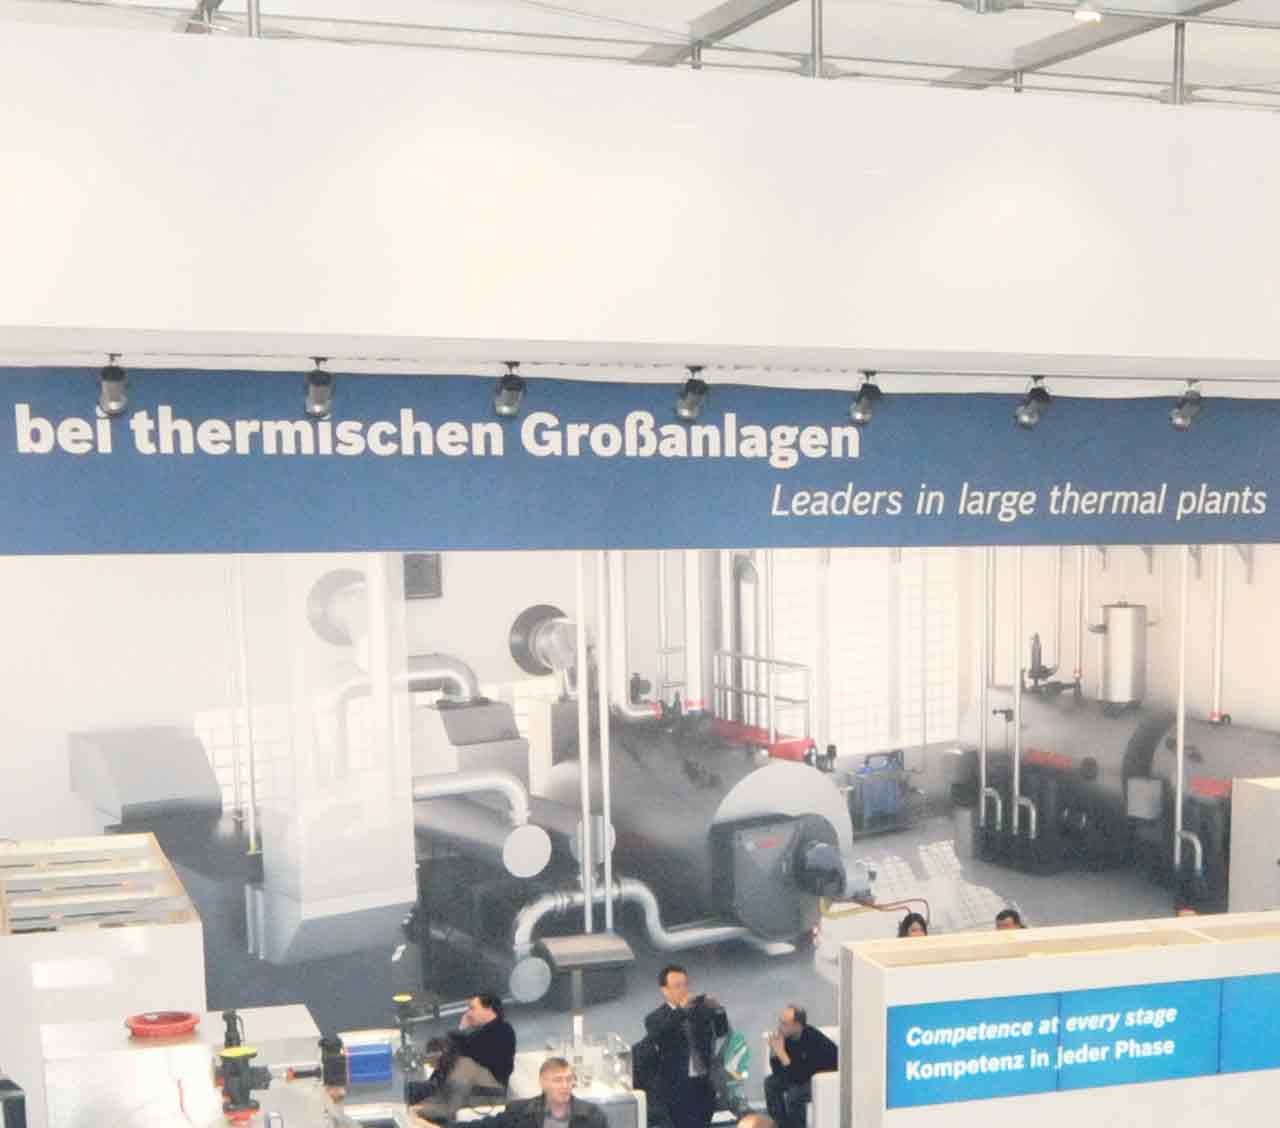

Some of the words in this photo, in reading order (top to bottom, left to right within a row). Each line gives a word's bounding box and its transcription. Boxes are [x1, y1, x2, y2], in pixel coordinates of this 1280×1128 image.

[15, 403, 113, 454] bei
[130, 406, 504, 457] thermischen
[521, 411, 861, 469] Großanlagen
[771, 484, 903, 516] Leaders
[916, 484, 945, 515] in
[958, 483, 1038, 522] large
[1049, 484, 1167, 515] thermal
[1176, 485, 1268, 520] plants
[906, 1021, 1034, 1048] Competence
[1038, 1016, 1059, 1034] at
[1066, 1011, 1120, 1032] every
[1125, 1007, 1178, 1028] stage
[906, 1054, 1025, 1080] Kompetenz
[1030, 1048, 1049, 1069] in
[1055, 1043, 1110, 1069] jeder
[1115, 1039, 1176, 1060] Phase
